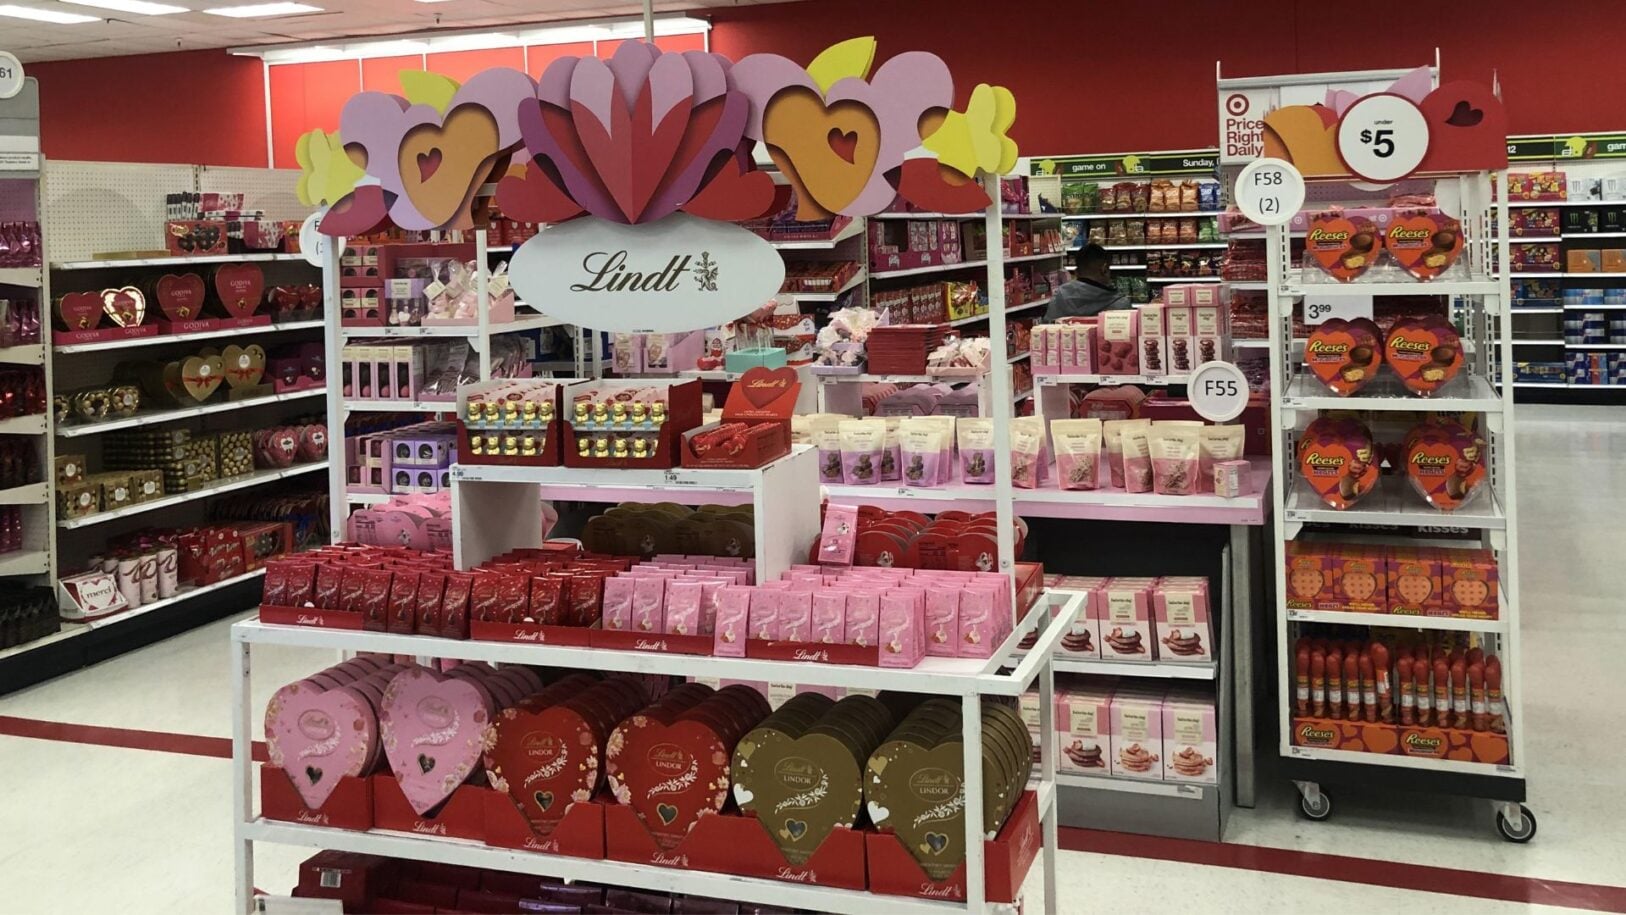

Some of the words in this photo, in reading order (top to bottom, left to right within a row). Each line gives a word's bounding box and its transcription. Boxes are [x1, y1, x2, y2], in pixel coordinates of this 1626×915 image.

[1226, 118, 1265, 130] Price
[1226, 131, 1265, 146] Right
[1360, 129, 1395, 158] $5
[1226, 143, 1264, 158] Daily
[1072, 164, 1094, 173] game
[1182, 158, 1215, 168] Sunday,
[1254, 171, 1283, 186] F58
[1258, 197, 1280, 214] (2)
[569, 250, 693, 292] Lindt
[183, 321, 210, 330] GODIVA
[747, 379, 779, 388] Lindt
[1205, 380, 1238, 396] F55
[86, 587, 112, 599] merci
[296, 614, 319, 624] Lindt
[513, 629, 538, 641] Lindt
[634, 639, 660, 650] Lindt
[793, 649, 820, 661] Lindt
[528, 748, 553, 756] LINDOR
[653, 749, 678, 760] Lindt
[655, 761, 682, 770] LINDOR
[783, 775, 811, 785] LINDOR
[919, 786, 949, 795] LINDOR
[297, 811, 322, 823] Lindt
[413, 821, 439, 834] Lindt
[523, 837, 552, 851] Lindt
[651, 852, 681, 866] Lindt
[776, 866, 808, 882] Lindt
[919, 882, 952, 897] Lindt
